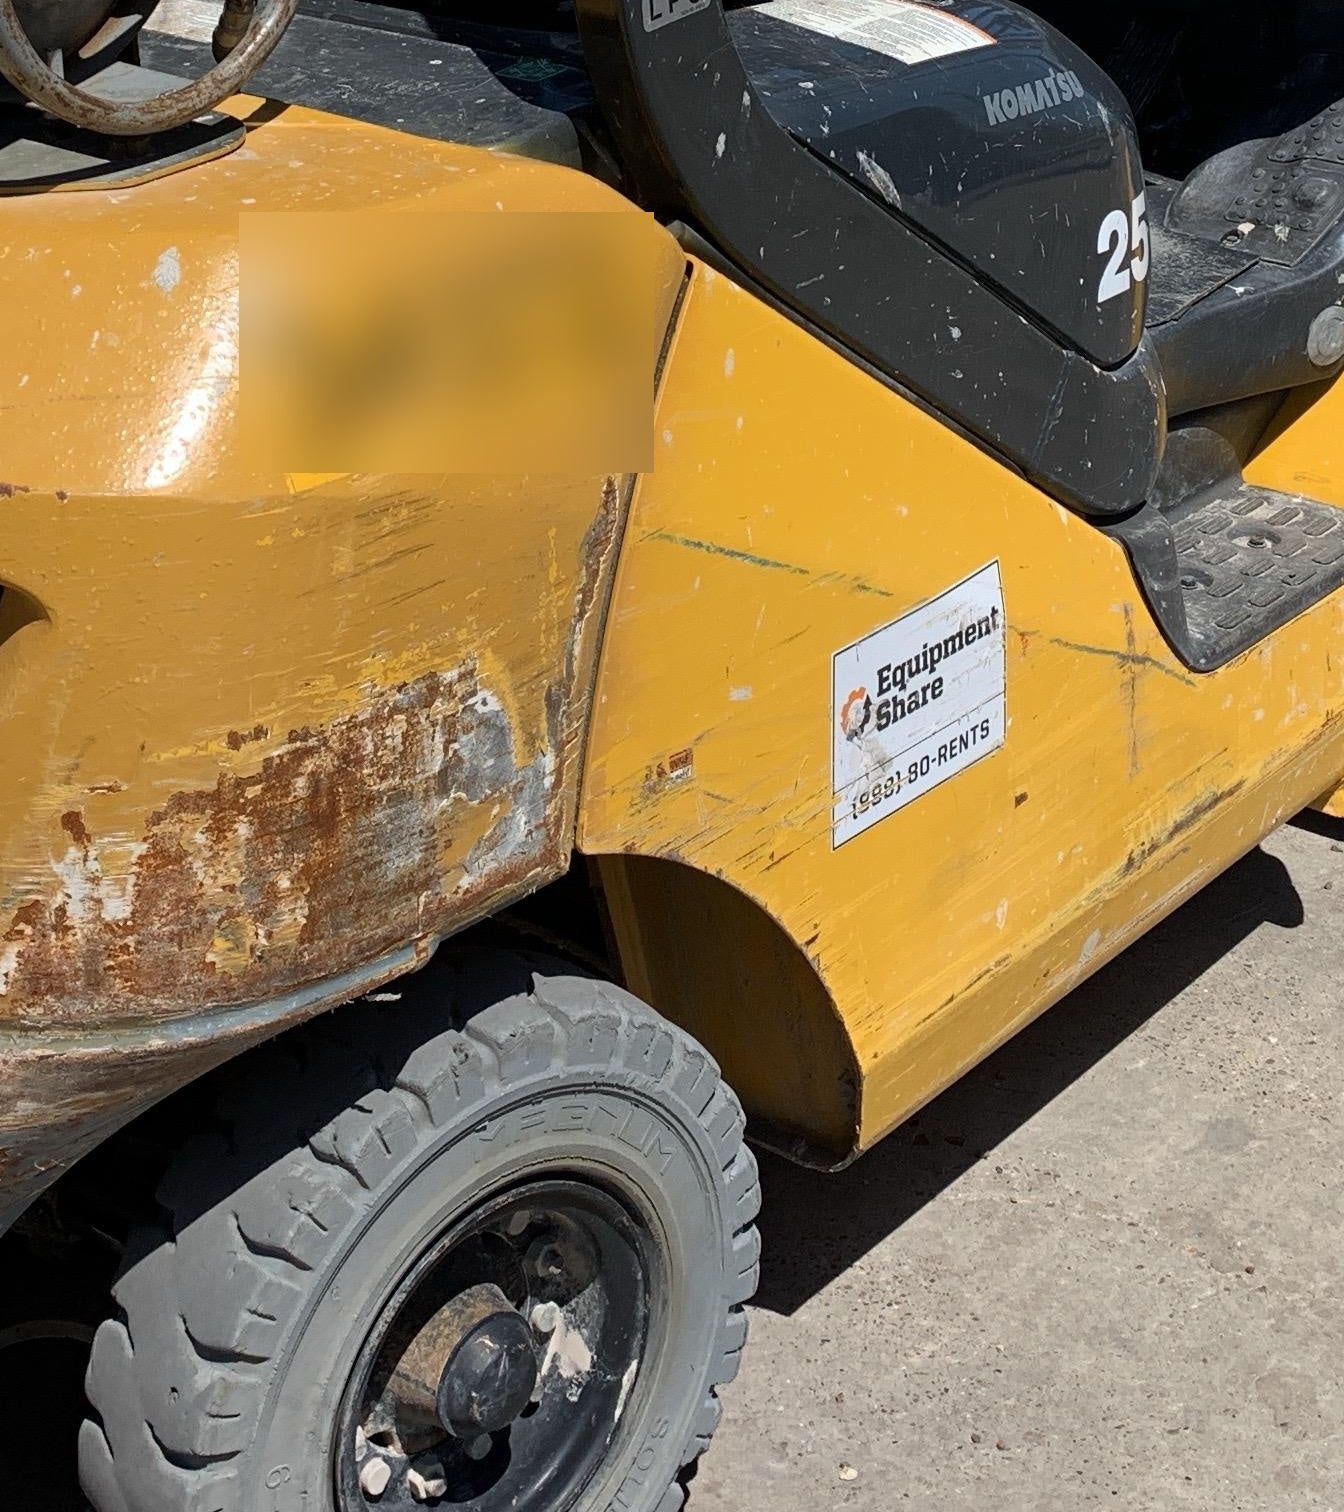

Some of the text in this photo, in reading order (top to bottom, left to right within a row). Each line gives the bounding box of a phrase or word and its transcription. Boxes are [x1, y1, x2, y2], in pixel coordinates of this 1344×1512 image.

[982, 68, 1085, 127] KOMATSU
[1097, 191, 1150, 304] 25
[876, 605, 1000, 698] Equipment
[875, 676, 944, 733] Share
[907, 718, 991, 785] 80-RENTS
